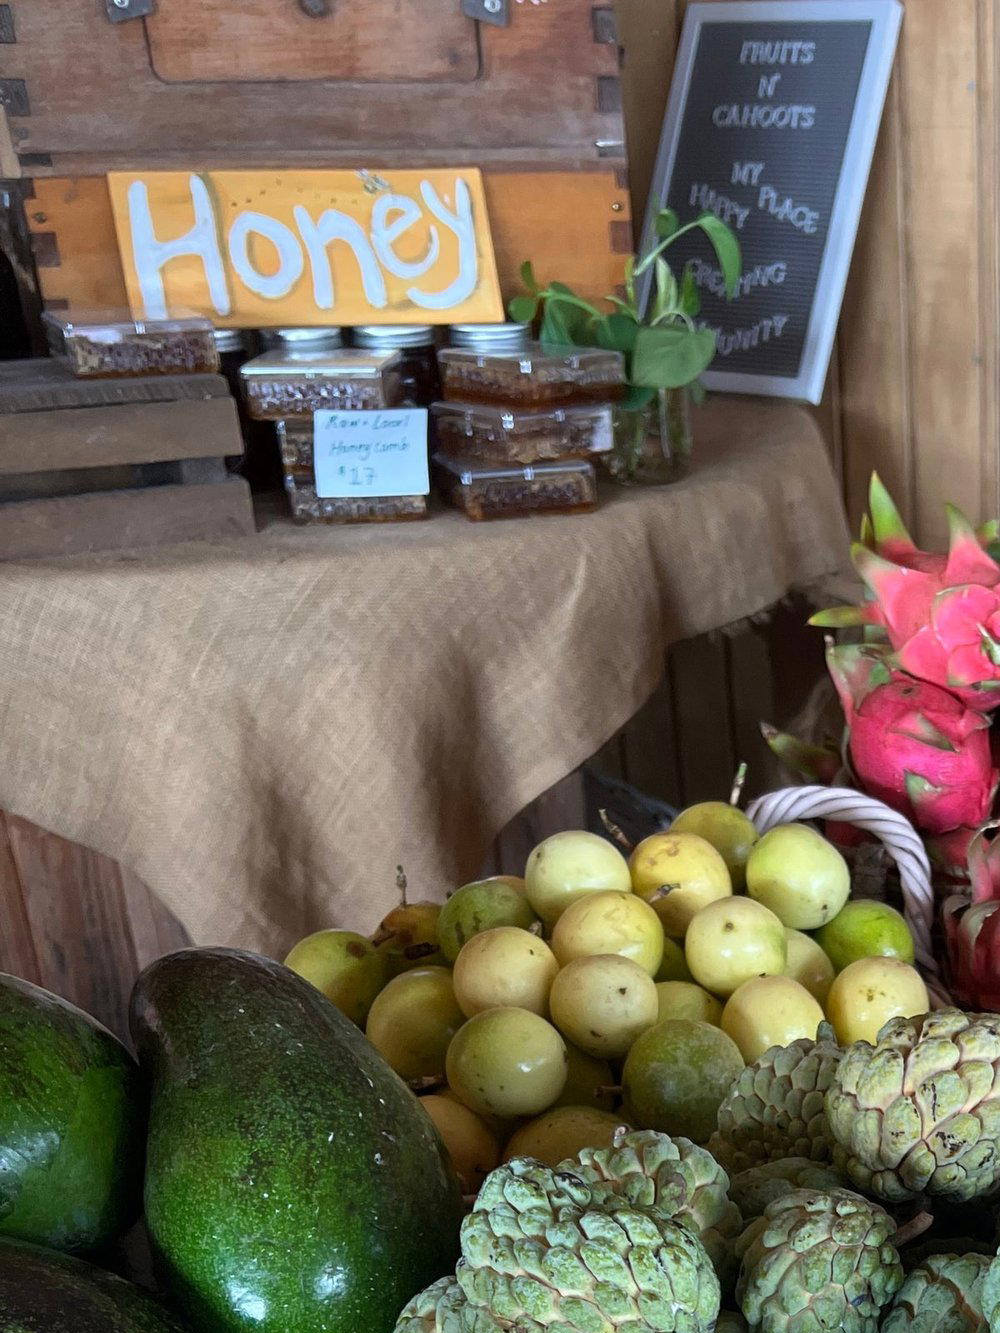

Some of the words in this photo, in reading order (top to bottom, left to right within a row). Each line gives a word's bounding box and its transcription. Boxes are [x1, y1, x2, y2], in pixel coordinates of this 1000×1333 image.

[740, 40, 816, 64] FRUITS
[712, 104, 816, 129] CAHOOTS
[731, 162, 764, 186] MY
[758, 186, 819, 233] PLACE
[128, 173, 478, 320] Honey
